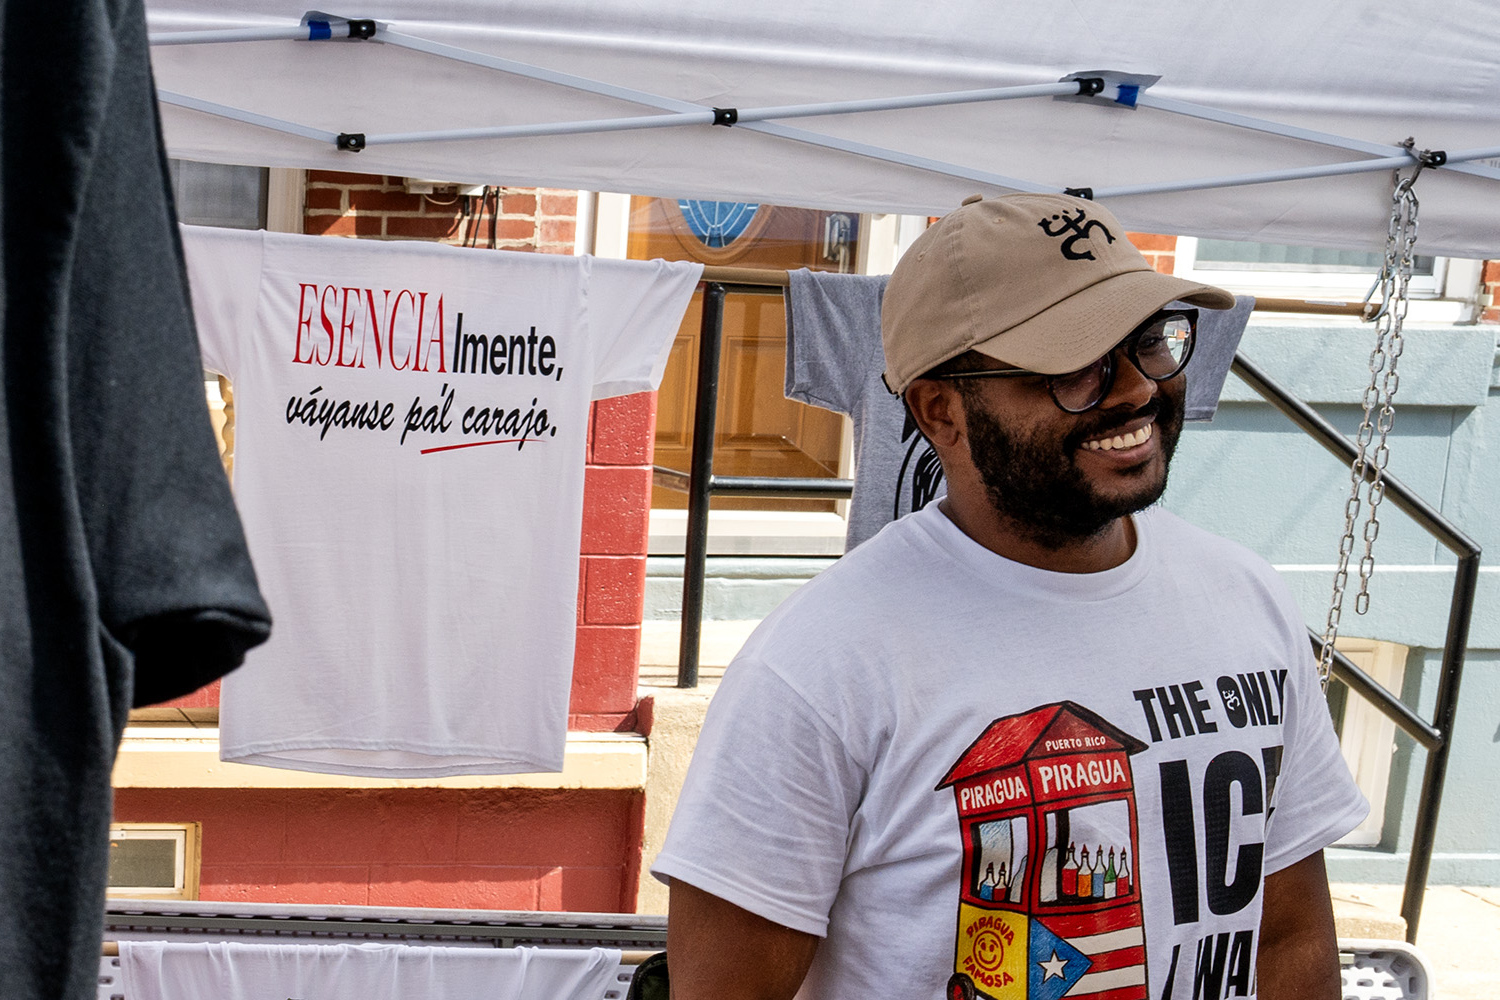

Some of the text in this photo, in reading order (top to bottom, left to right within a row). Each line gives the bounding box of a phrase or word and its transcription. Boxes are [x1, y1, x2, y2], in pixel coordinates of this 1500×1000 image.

[286, 386, 395, 441] váyanse
[462, 397, 557, 451] carajo.
[1133, 669, 1288, 743] THE ONLY
[1045, 736, 1106, 752] PUERTO RICO
[960, 776, 1028, 811] PIRAGUA
[1038, 759, 1126, 794] PIRAGUA
[966, 916, 1014, 946] PIRAGUA
[963, 955, 1014, 988] FAMOSA
